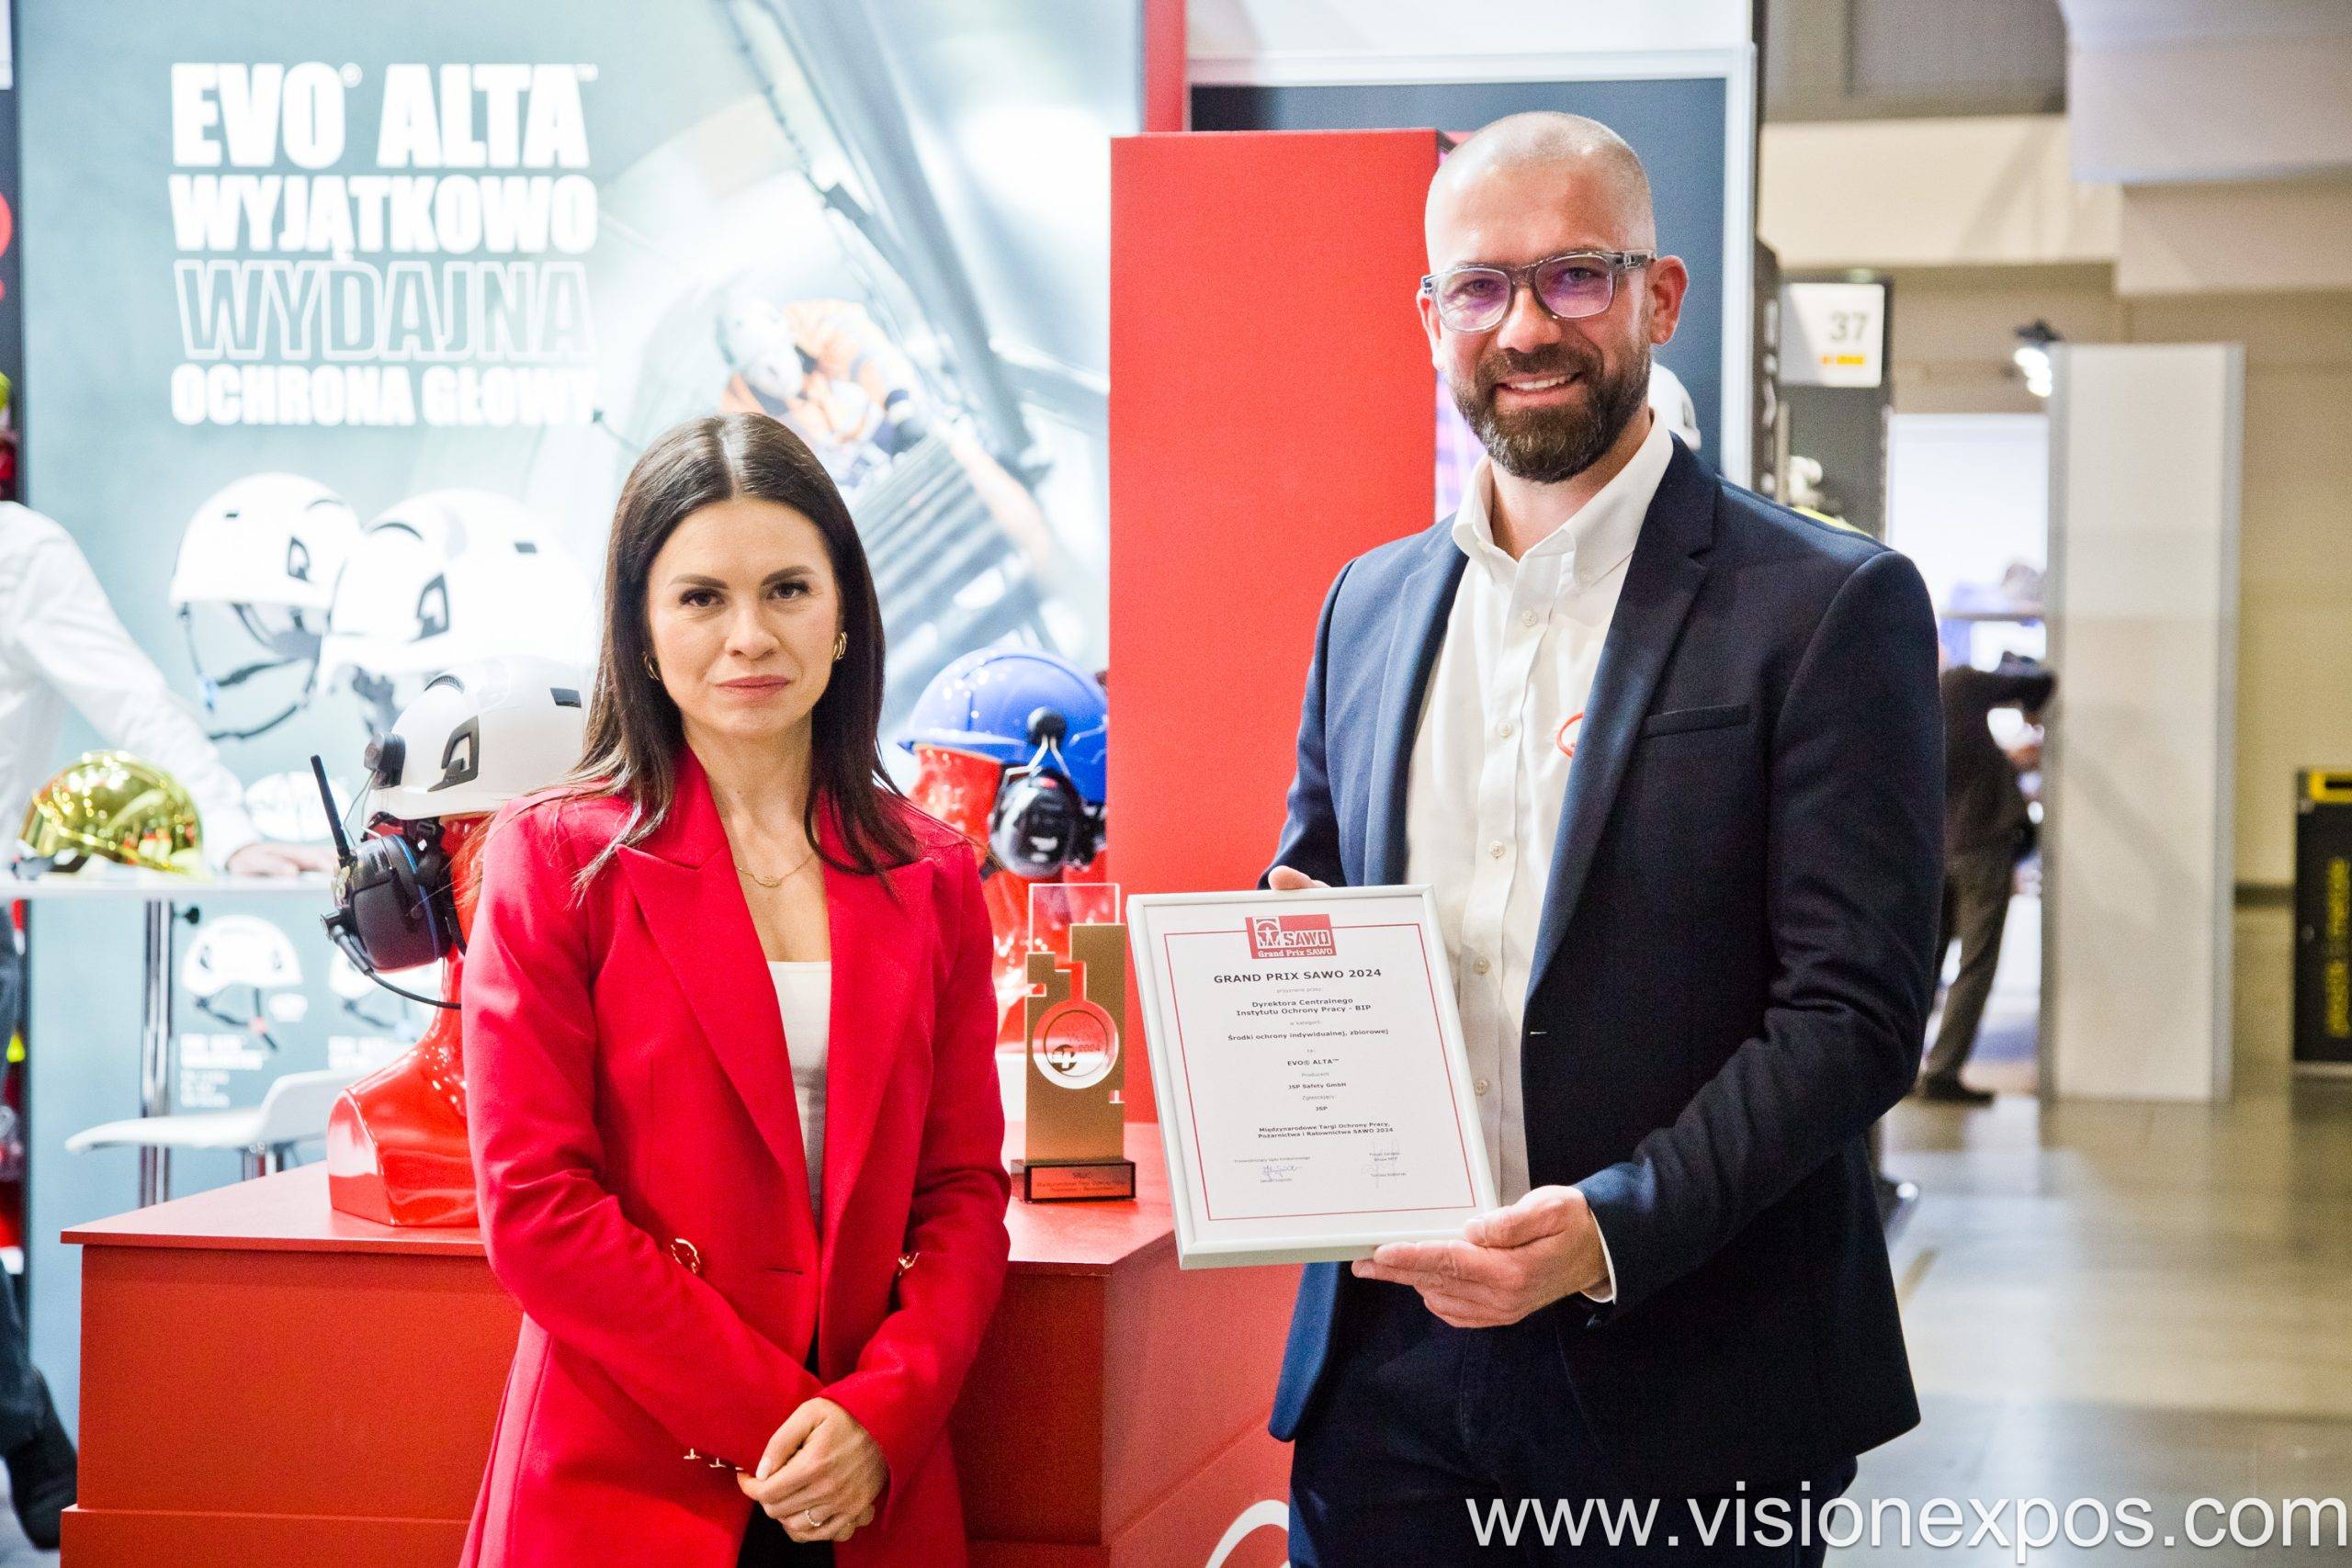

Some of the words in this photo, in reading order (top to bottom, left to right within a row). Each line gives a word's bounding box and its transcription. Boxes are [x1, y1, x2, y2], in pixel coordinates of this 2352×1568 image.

[169, 175, 598, 262] WYJĄTKOWO
[174, 259, 595, 361] WYDAJNA
[1829, 310, 1869, 343] 37
[171, 365, 415, 427] OCHRONA
[1283, 931, 1330, 946] SAWO
[1258, 950, 1284, 958] Grand
[1286, 949, 1305, 957] Prix
[1306, 947, 1333, 956] SAWO
[1214, 974, 1261, 984] GRAND
[1267, 972, 1299, 982] PRIX
[1304, 970, 1344, 980] SAWO
[1349, 968, 1382, 978] 2024
[1237, 1008, 1279, 1017] Instytutu
[1281, 1006, 1318, 1015] Ochrony
[1321, 1005, 1346, 1013] Pracy
[1251, 999, 1297, 1009] Dyrektora
[1298, 998, 1353, 1007] Centralnego
[1227, 1033, 1253, 1042] Środki
[1255, 1032, 1287, 1041] ochrony
[1350, 1027, 1389, 1036] zbiorowej
